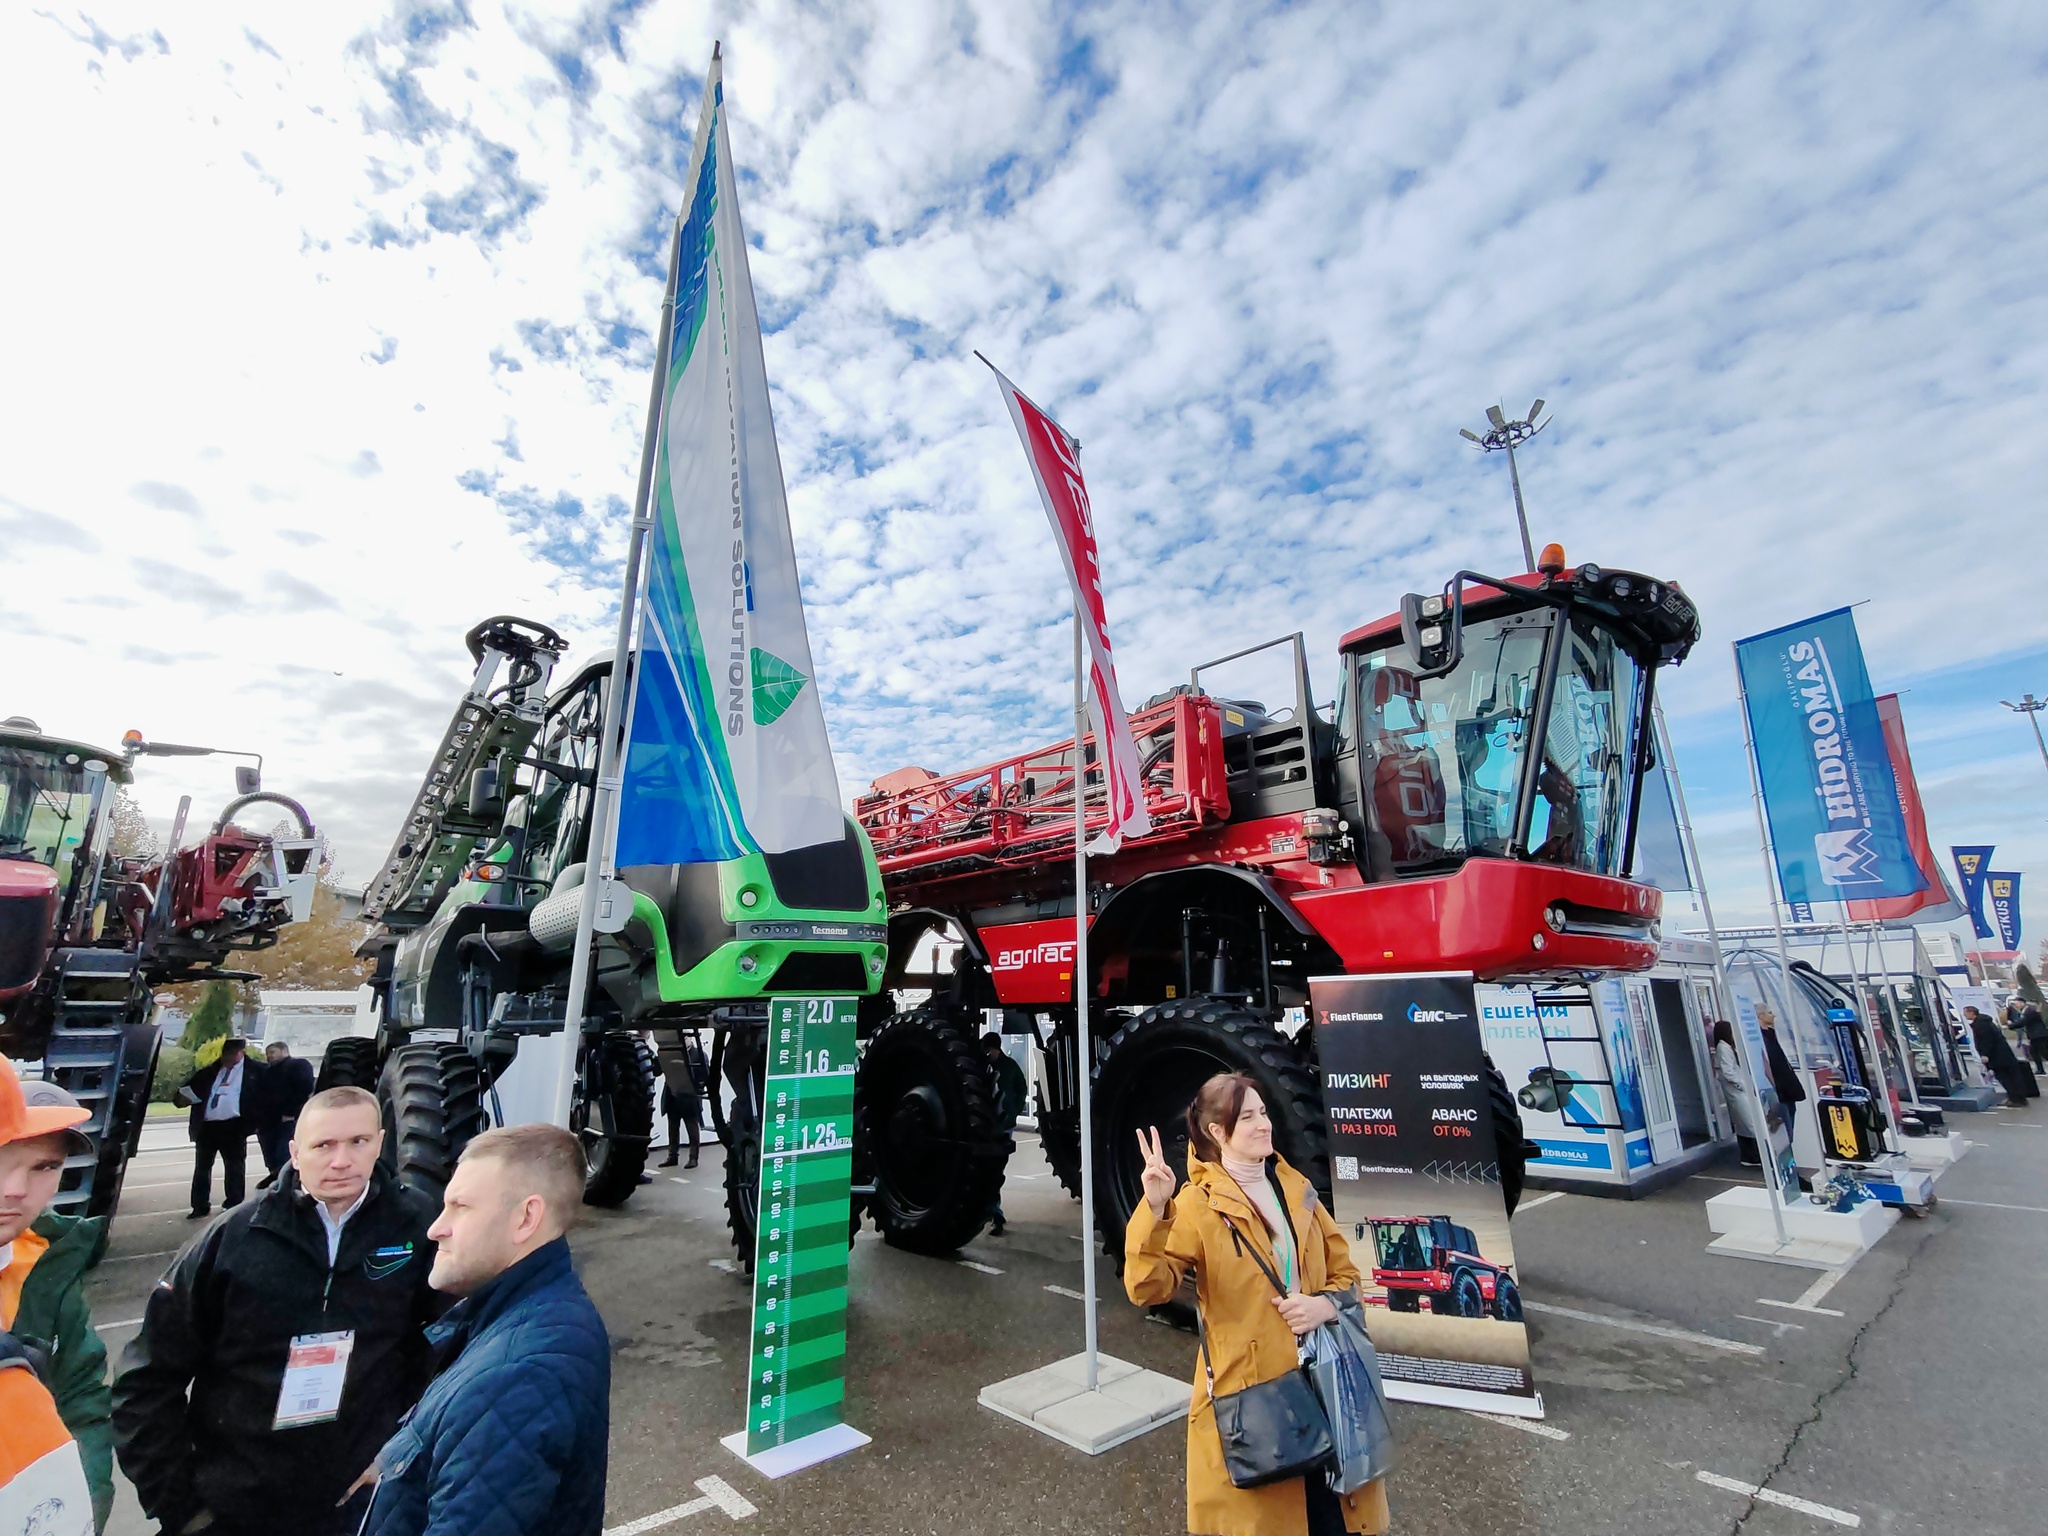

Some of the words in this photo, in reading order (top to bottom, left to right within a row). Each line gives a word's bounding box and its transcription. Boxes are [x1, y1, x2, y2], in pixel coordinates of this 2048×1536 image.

[727, 539, 744, 737] SOLUTIONS
[811, 925, 848, 935] Tecnoma
[994, 941, 1077, 971] agrifac
[782, 1007, 792, 1023] 190
[806, 999, 834, 1024] 2.0
[1330, 1012, 1351, 1022] Fleet
[1351, 1011, 1383, 1021] Finance
[1483, 1005, 1569, 1019] ЕШЕНИЯ
[781, 1028, 791, 1044] 180
[1486, 1025, 1571, 1039] ПЛЕКТЫ
[779, 1049, 790, 1065] 170
[804, 1049, 829, 1074] 1.6
[1327, 1074, 1392, 1089] ЛИЗИНГ
[1419, 1074, 1433, 1082] НА
[1433, 1074, 1480, 1083] ВЫГОДНЫХ
[1420, 1082, 1465, 1090] УСЛОВИЯХ
[776, 1092, 787, 1108] 150
[1330, 1107, 1393, 1120] ПЛАТЕЖИ
[1431, 1109, 1478, 1121] АВАНС
[775, 1113, 786, 1130] 140
[801, 1122, 837, 1151] 1.25
[1333, 1124, 1339, 1134] 1
[1341, 1124, 1362, 1135] РАЗ
[1364, 1124, 1372, 1135] В
[1373, 1124, 1398, 1137] ГОД
[1433, 1125, 1450, 1137] ОТ
[1452, 1125, 1472, 1137] 0%
[774, 1135, 785, 1152] 130
[773, 1157, 784, 1174] 120
[1360, 1165, 1413, 1175] fleetfinance.ru
[772, 1180, 782, 1197] 110
[771, 1202, 781, 1219] 100
[769, 1227, 780, 1241] 90
[768, 1250, 779, 1264] 80
[767, 1274, 778, 1288] 70
[766, 1297, 776, 1311] 60
[765, 1321, 775, 1335] 50
[763, 1345, 774, 1359] 40
[762, 1369, 773, 1384] 30
[761, 1394, 772, 1409] 20
[760, 1419, 771, 1433] 10
